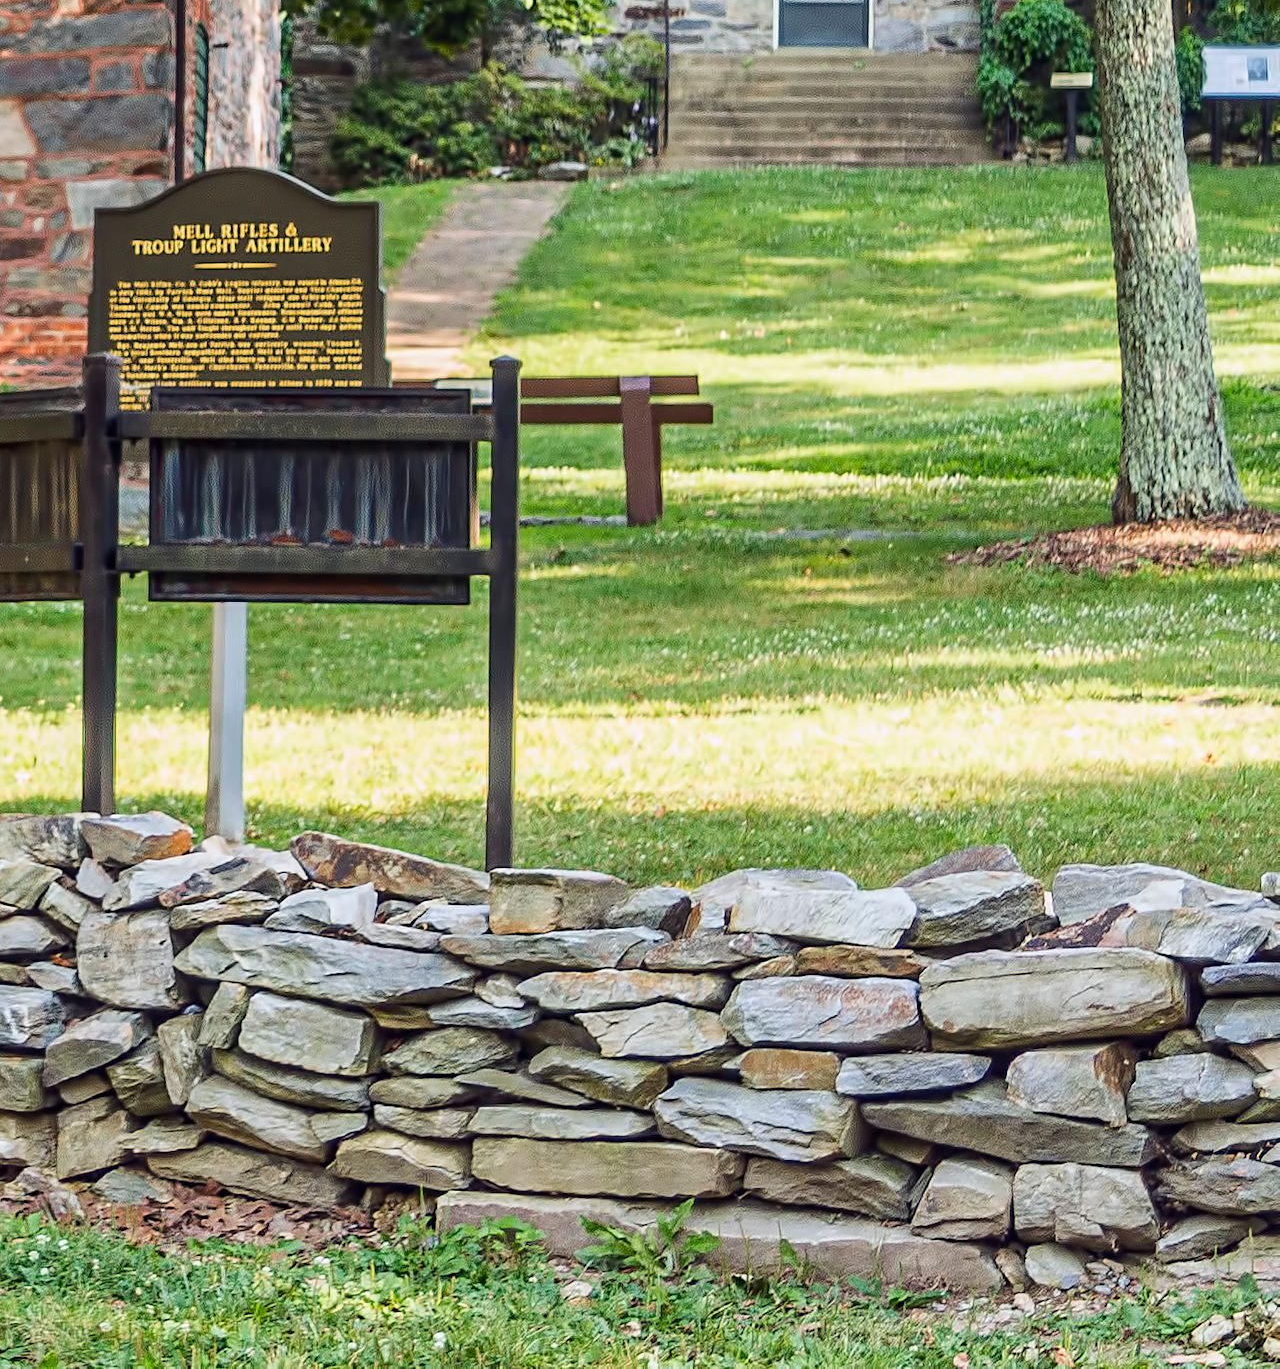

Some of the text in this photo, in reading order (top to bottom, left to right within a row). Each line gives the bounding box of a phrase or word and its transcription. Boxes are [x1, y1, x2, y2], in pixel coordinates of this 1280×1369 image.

[173, 221, 297, 239] MELL RIFLES &
[132, 237, 332, 255] TROUP LIGHT ARTILLERY
